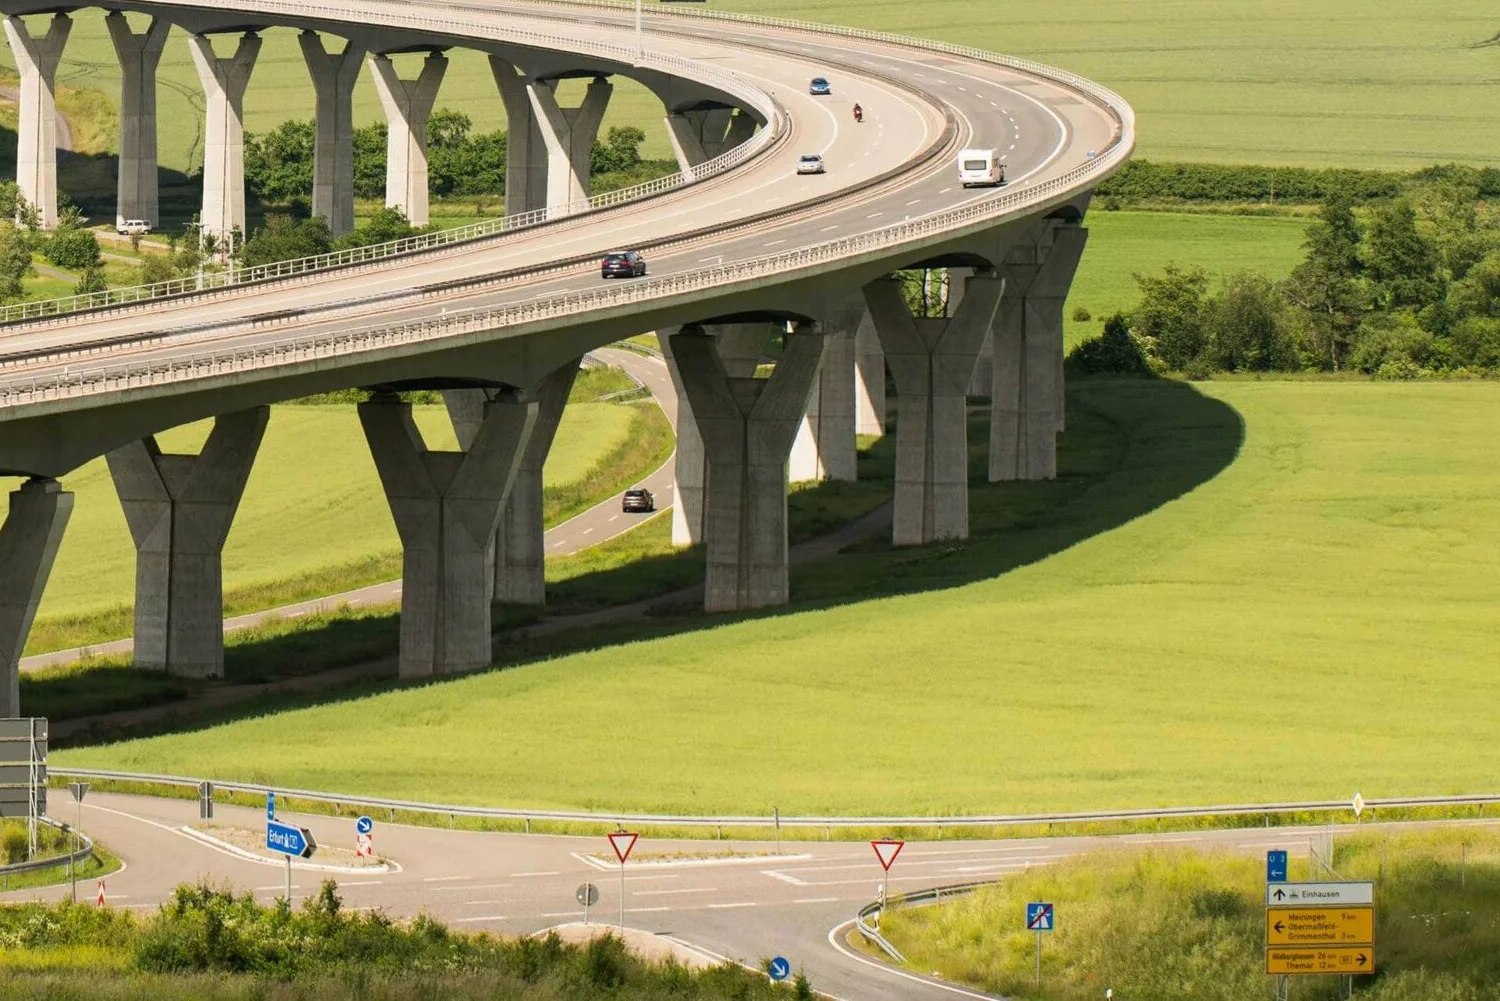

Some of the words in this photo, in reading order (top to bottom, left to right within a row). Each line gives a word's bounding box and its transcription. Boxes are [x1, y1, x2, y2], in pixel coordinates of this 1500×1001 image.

[269, 829, 284, 846] Erfurt
[1302, 890, 1340, 898] Einhausen
[1288, 913, 1326, 922] Meiningen
[1288, 932, 1336, 940] Grimmenthal
[1286, 961, 1314, 969] Themar
[1319, 961, 1326, 969] 12
